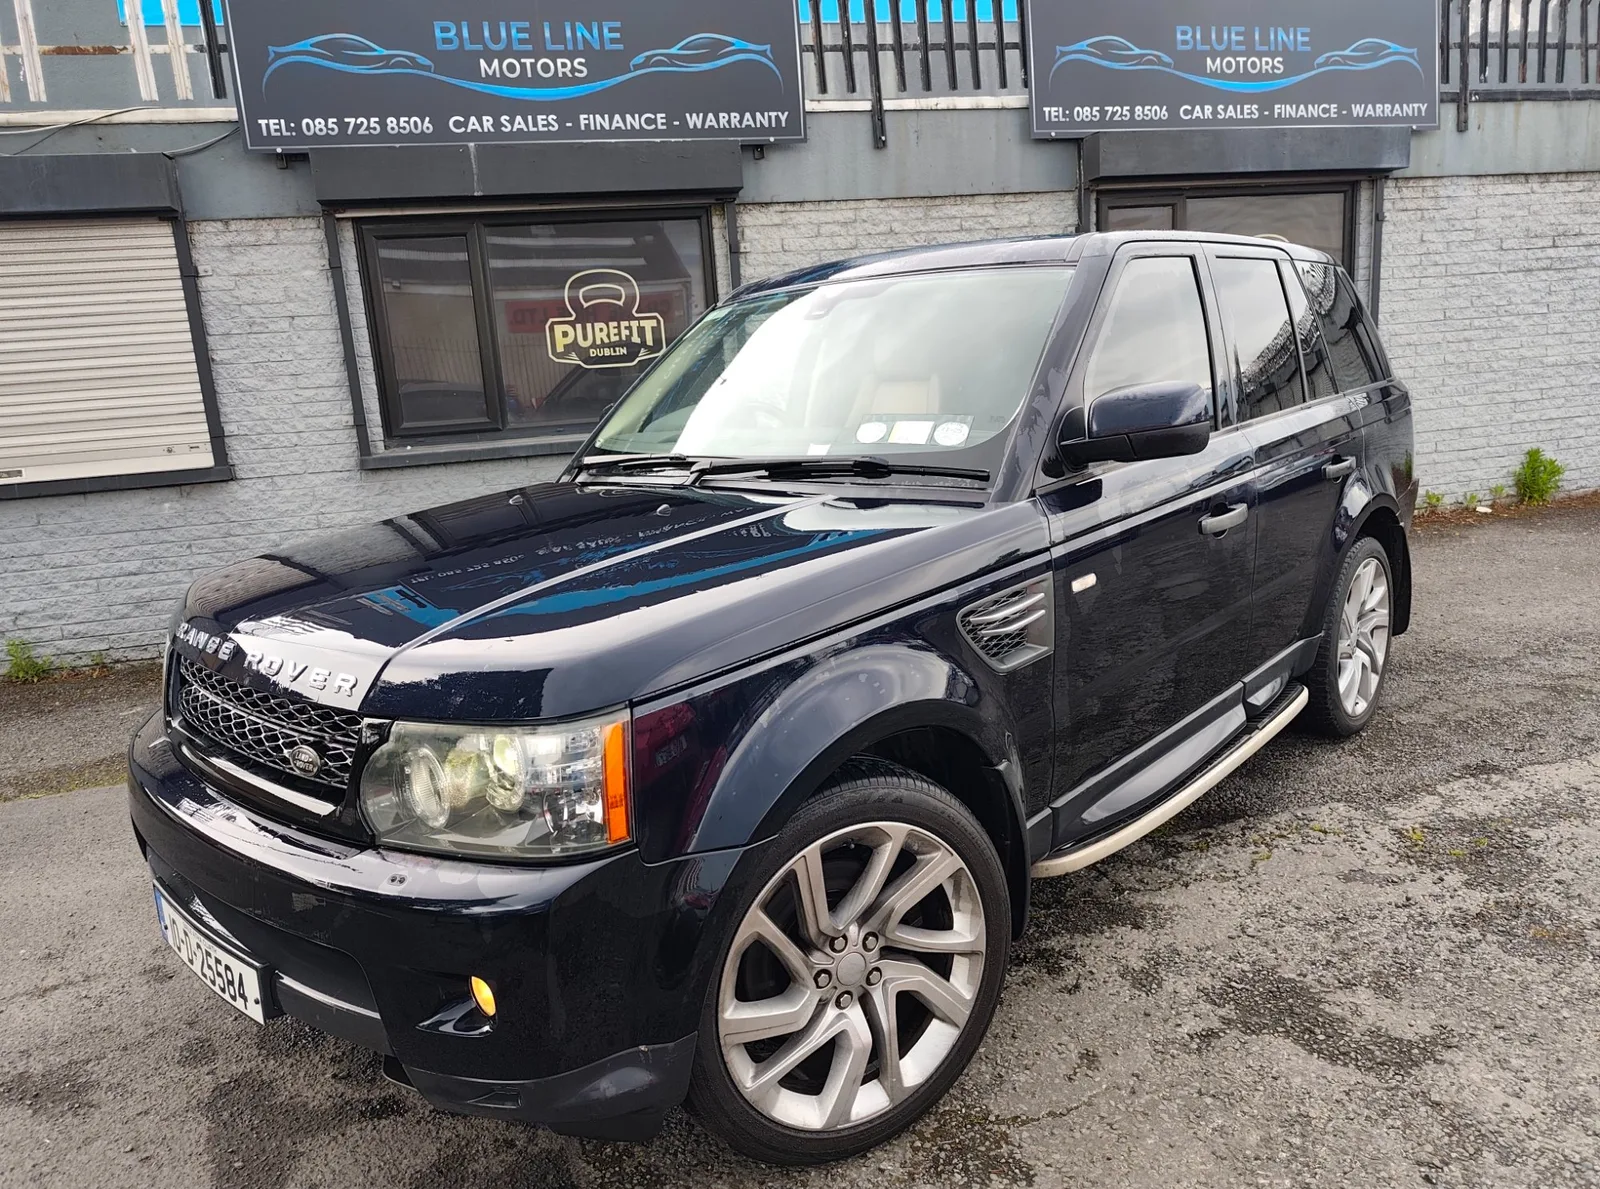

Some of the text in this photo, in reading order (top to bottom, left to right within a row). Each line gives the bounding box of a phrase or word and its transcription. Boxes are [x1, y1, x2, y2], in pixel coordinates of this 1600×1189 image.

[433, 21, 624, 50] BLUE LINE
[1176, 26, 1311, 51] BLUE LINE
[479, 58, 588, 78] MOTORS
[1206, 57, 1284, 74] MOTORS
[258, 118, 296, 137] TEL:
[302, 117, 339, 136] 085
[344, 116, 381, 135] 725
[386, 116, 434, 134] 8506
[449, 115, 495, 133] CAR
[500, 114, 559, 132] SALES
[579, 113, 667, 131] FINANCE
[685, 111, 789, 130] WARRANTY
[1043, 106, 1070, 122] TEL:
[1073, 106, 1100, 121] 085
[1104, 106, 1131, 121] 725
[1134, 105, 1168, 121] 8506
[1179, 105, 1213, 120] CAR
[1217, 104, 1259, 119] SALES
[1274, 103, 1338, 118] FINANCE
[1351, 103, 1427, 117] WARRANTY
[553, 319, 657, 353] PUREFIT
[589, 346, 627, 357] DUBLIN
[177, 622, 359, 697] RANGE ROVER
[168, 913, 249, 1011] 10-D-25584
